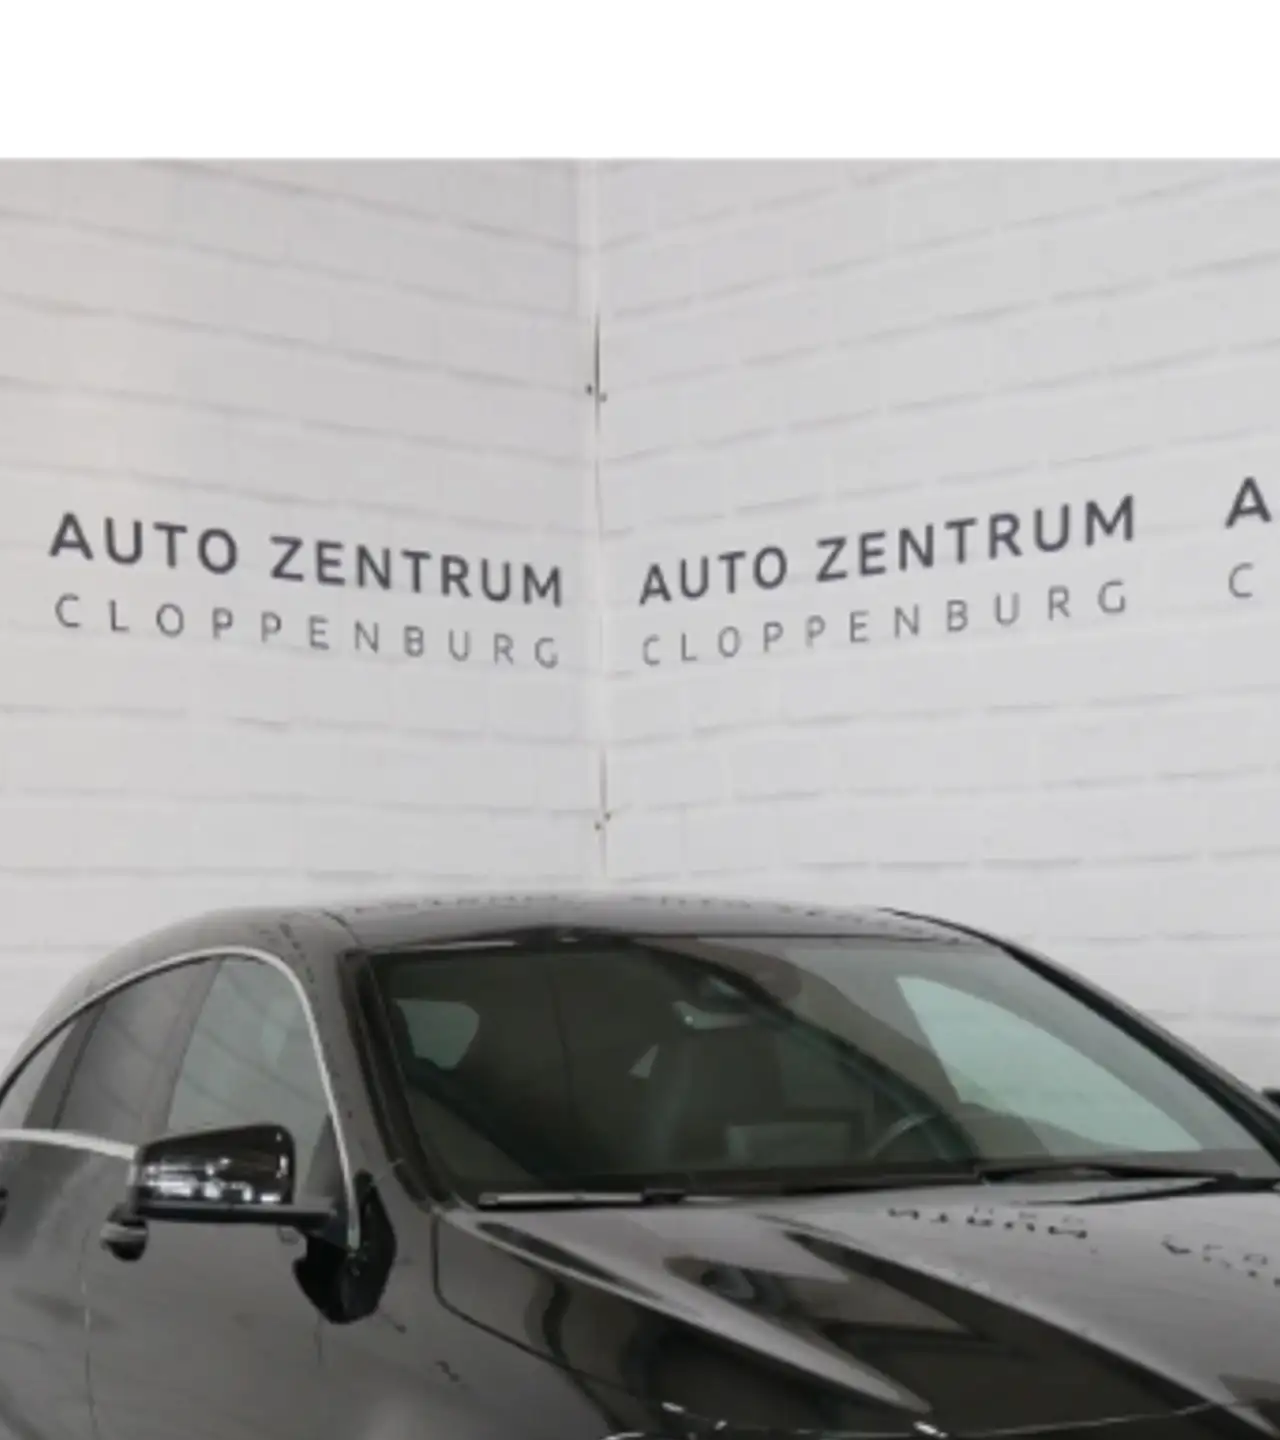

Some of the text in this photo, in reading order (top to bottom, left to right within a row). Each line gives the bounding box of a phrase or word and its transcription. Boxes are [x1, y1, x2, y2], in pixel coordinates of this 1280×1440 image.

[47, 511, 563, 609] AUTO ZENTRUM
[638, 493, 1135, 607] AUTO ZENTRUM
[54, 592, 559, 670] CLOPPENBURG
[641, 579, 1127, 667] CLOPPENBURG
